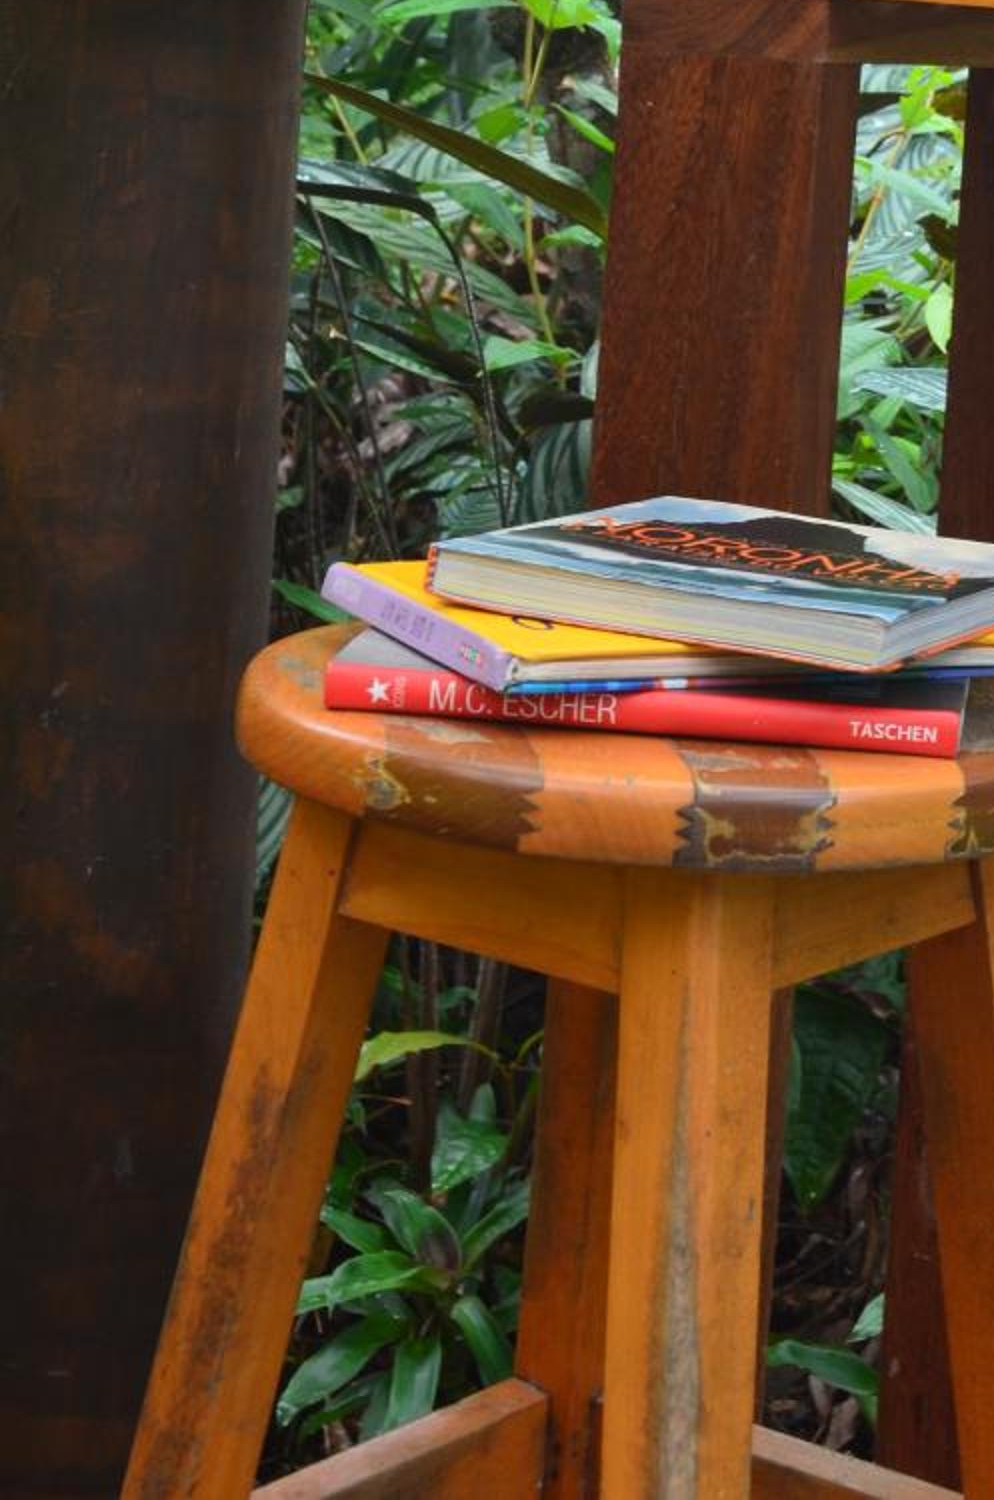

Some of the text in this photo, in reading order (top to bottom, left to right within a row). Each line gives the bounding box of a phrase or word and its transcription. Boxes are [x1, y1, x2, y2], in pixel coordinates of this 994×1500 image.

[560, 514, 962, 592] NORONHA
[428, 677, 492, 716] M.C.
[502, 688, 617, 726] ESCHER
[850, 720, 938, 743] TASCHEN
